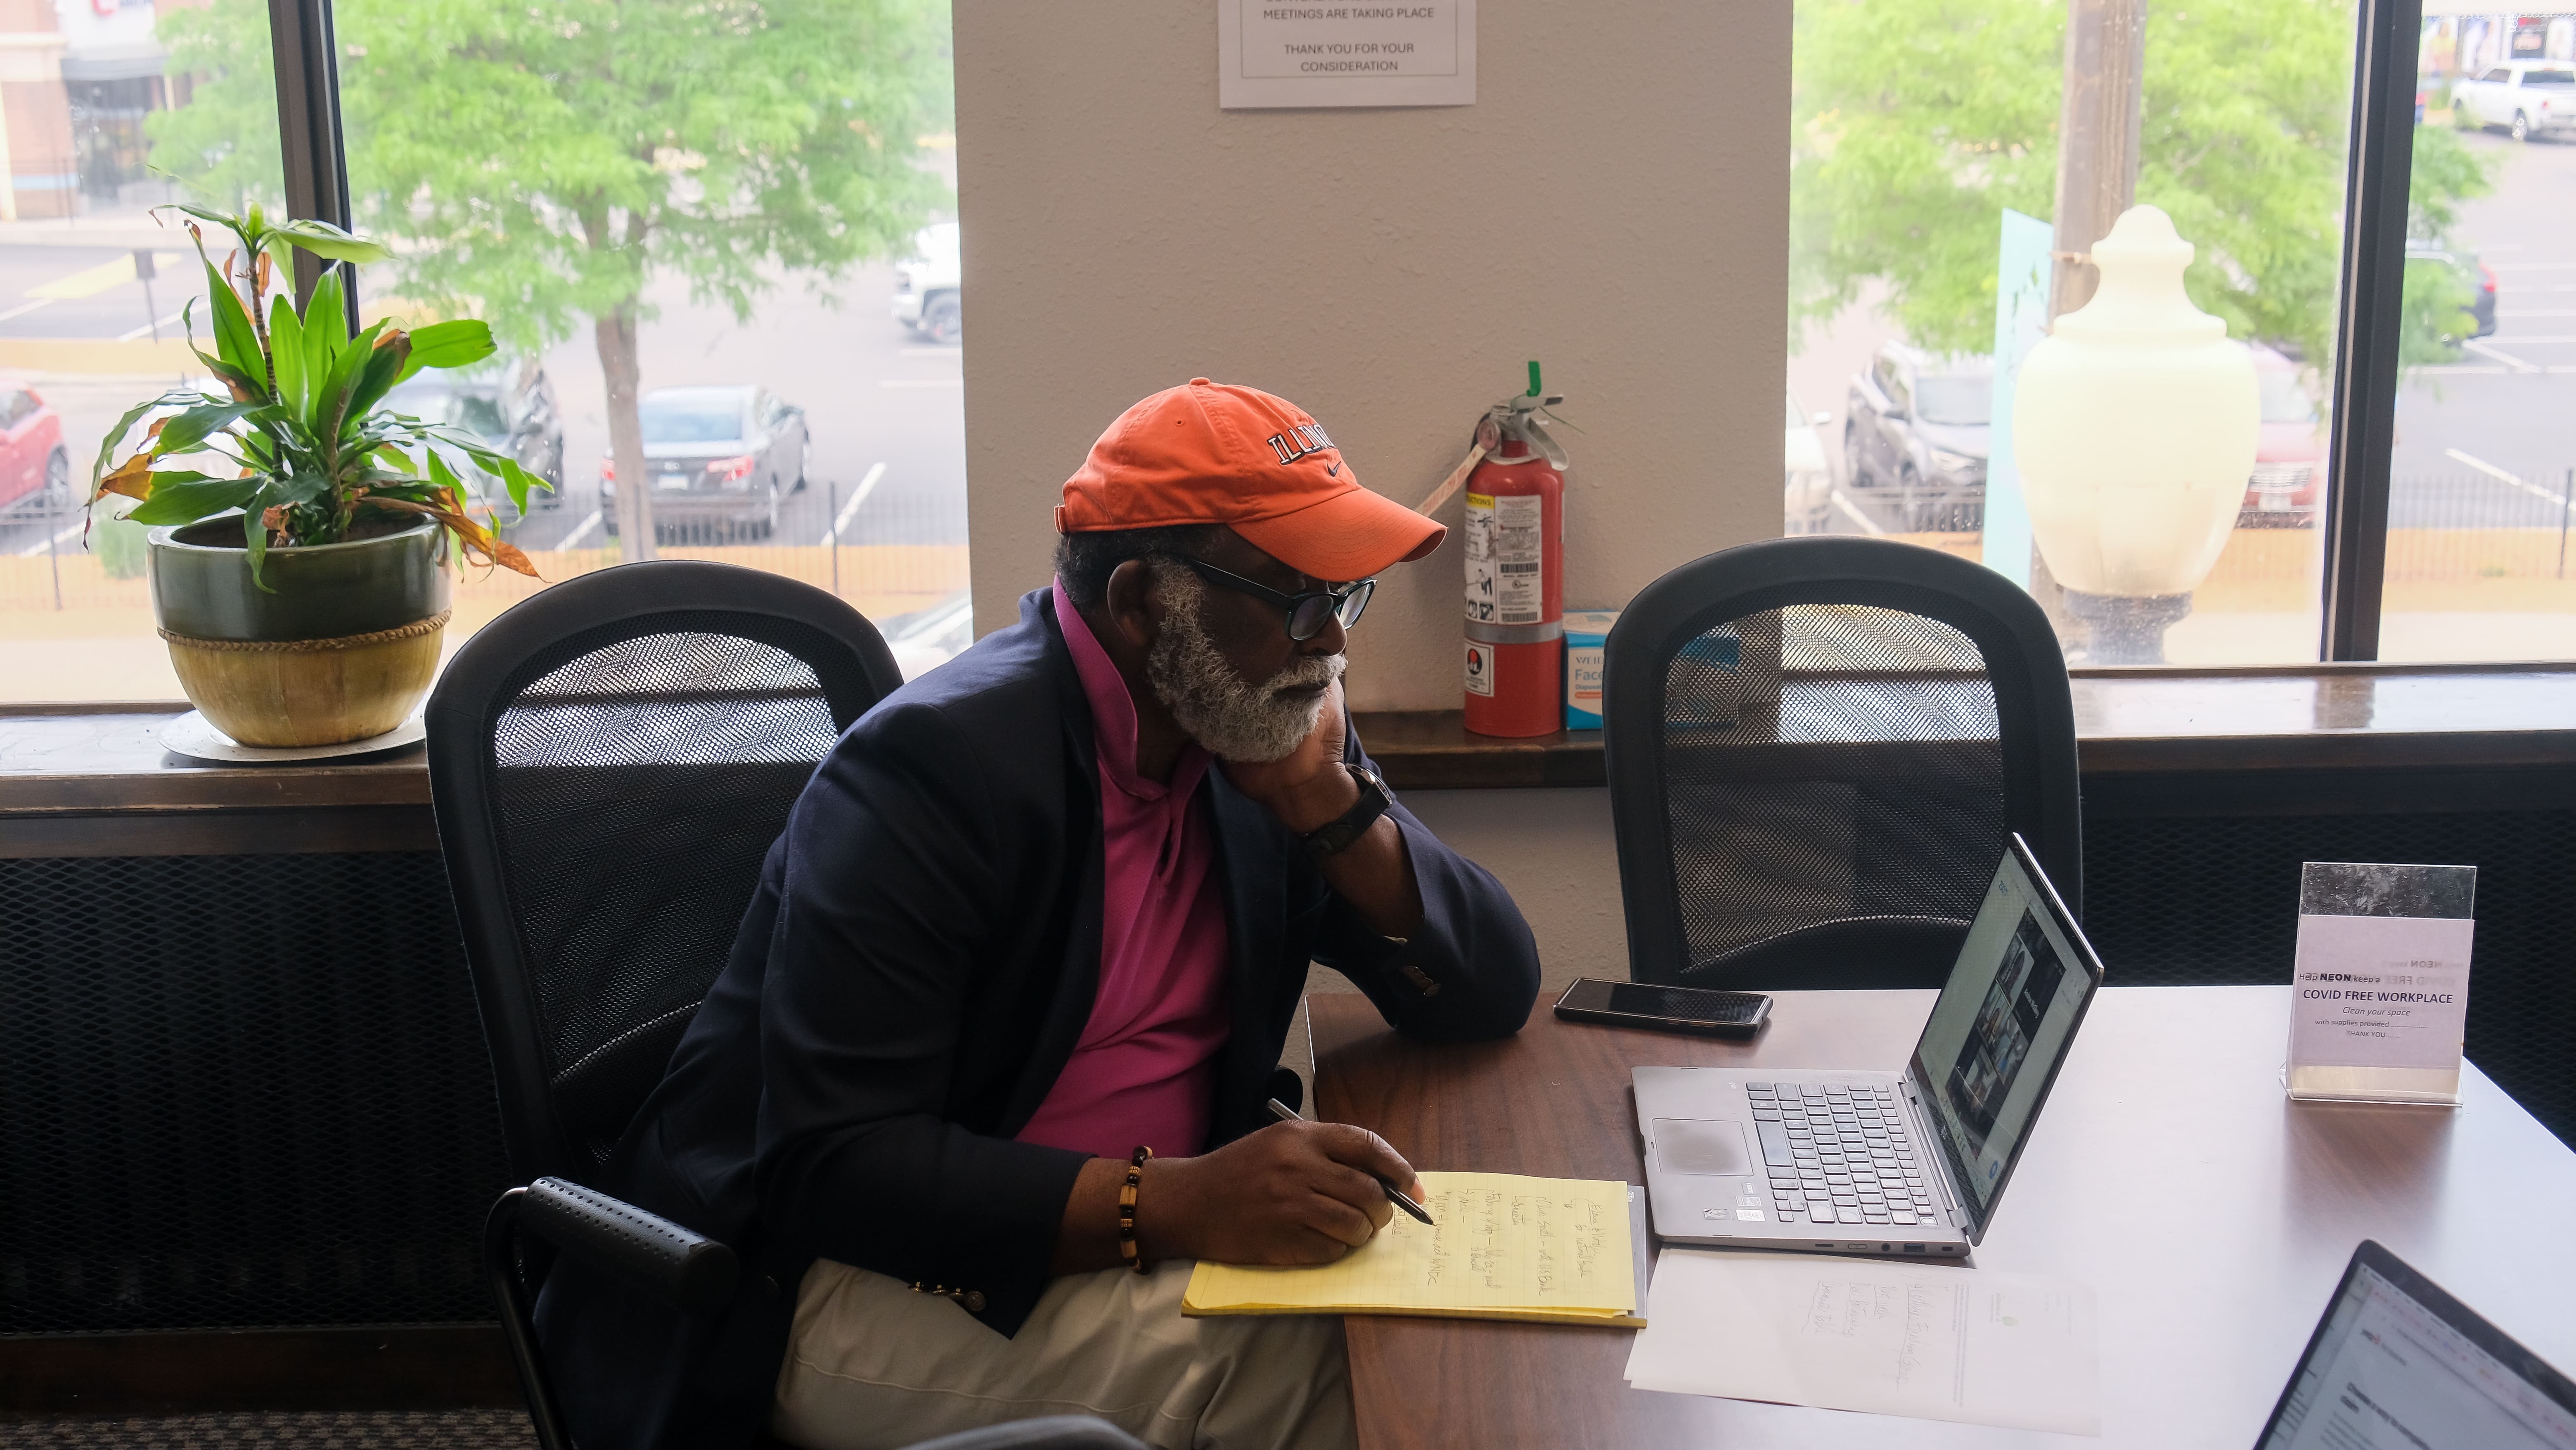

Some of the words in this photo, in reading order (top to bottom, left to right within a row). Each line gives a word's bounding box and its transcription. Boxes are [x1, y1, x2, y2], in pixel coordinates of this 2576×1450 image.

[1263, 9, 1323, 19] MEETINGS
[1326, 8, 1348, 19] ARE
[1352, 8, 1394, 18] TAKING
[1397, 7, 1434, 18] PLACE
[1285, 43, 1324, 54] THANK
[1326, 43, 1352, 54] YOU
[1354, 43, 1379, 54] FOR
[1382, 43, 1414, 53] YOUR
[1300, 61, 1398, 72] CONSIDERATION
[2299, 973, 2317, 981] Help
[2320, 973, 2351, 981] NEON
[2353, 975, 2373, 983] keep
[2303, 989, 2341, 999] COVID
[2345, 991, 2374, 1001] FREE
[2377, 992, 2453, 1003] WORKPLACE
